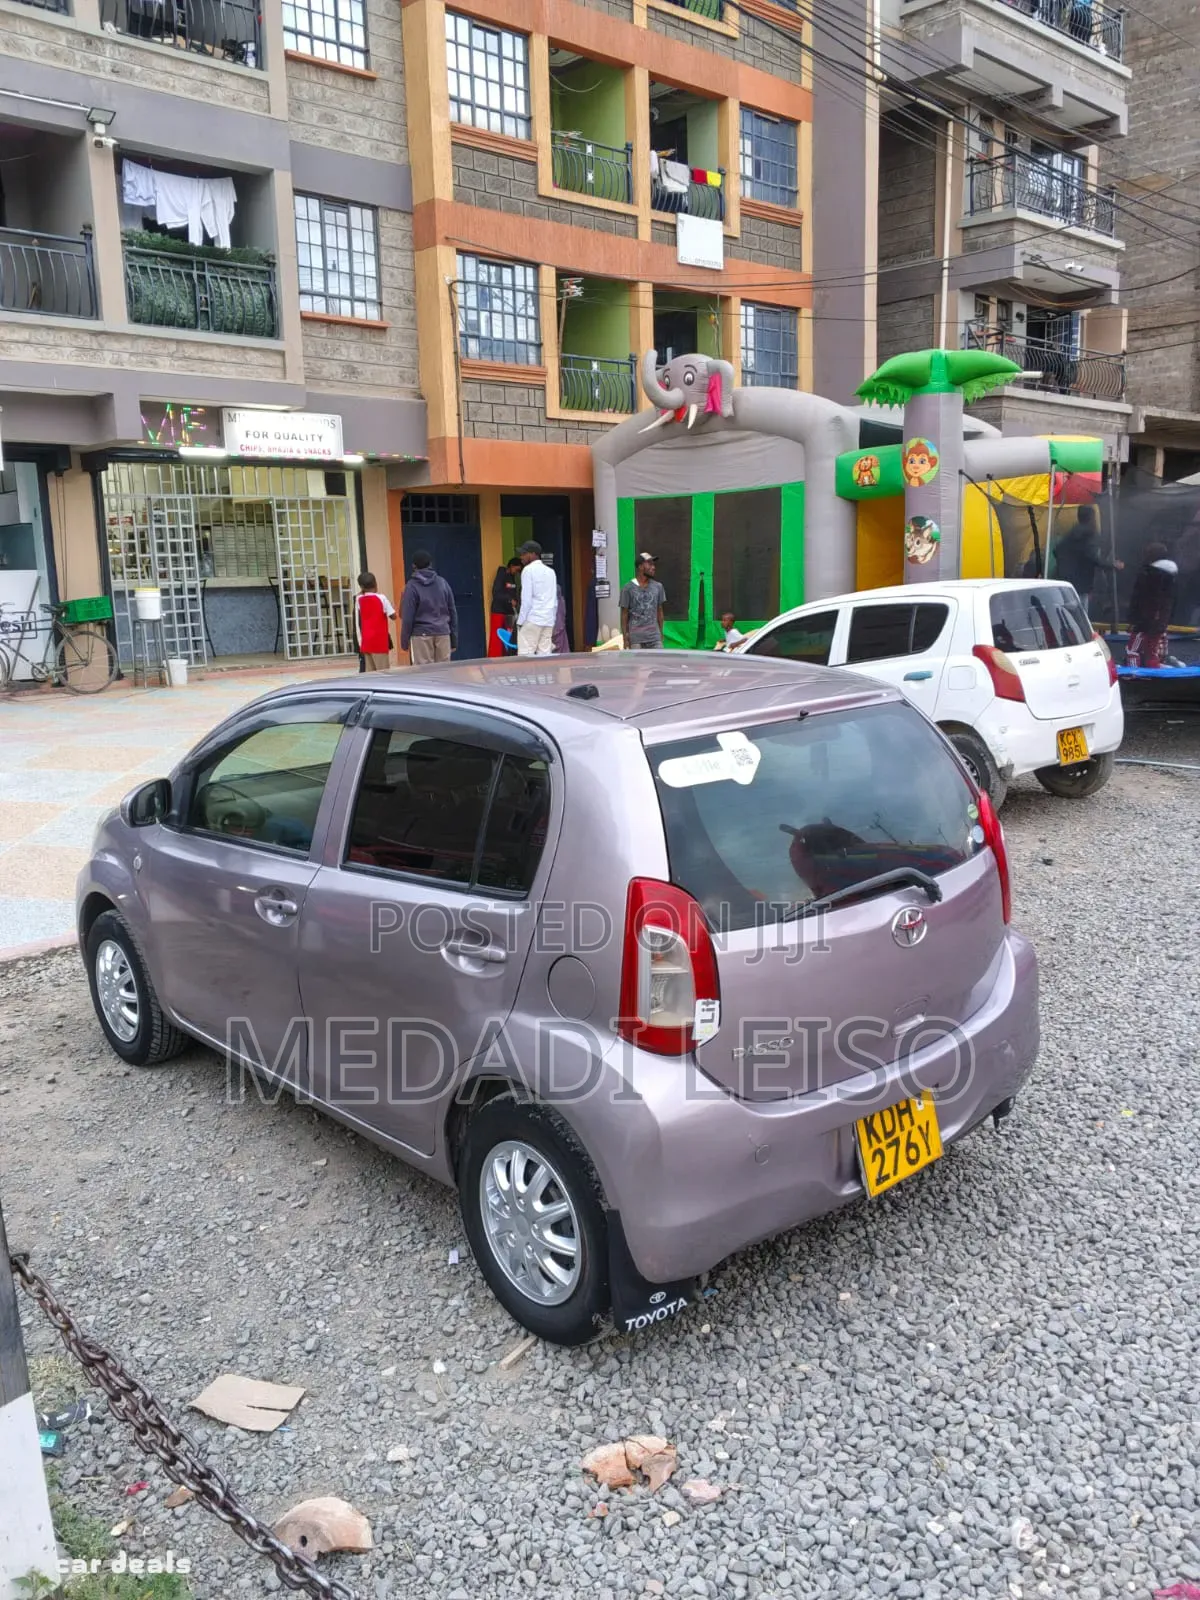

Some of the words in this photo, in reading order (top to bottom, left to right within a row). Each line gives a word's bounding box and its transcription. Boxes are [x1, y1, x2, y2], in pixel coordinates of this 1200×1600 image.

[245, 430, 269, 440] FOR
[273, 431, 324, 443] QUALITY
[863, 1098, 914, 1149] KDH
[871, 1120, 931, 1186] 276Y
[625, 1297, 688, 1331] TOYOTA
